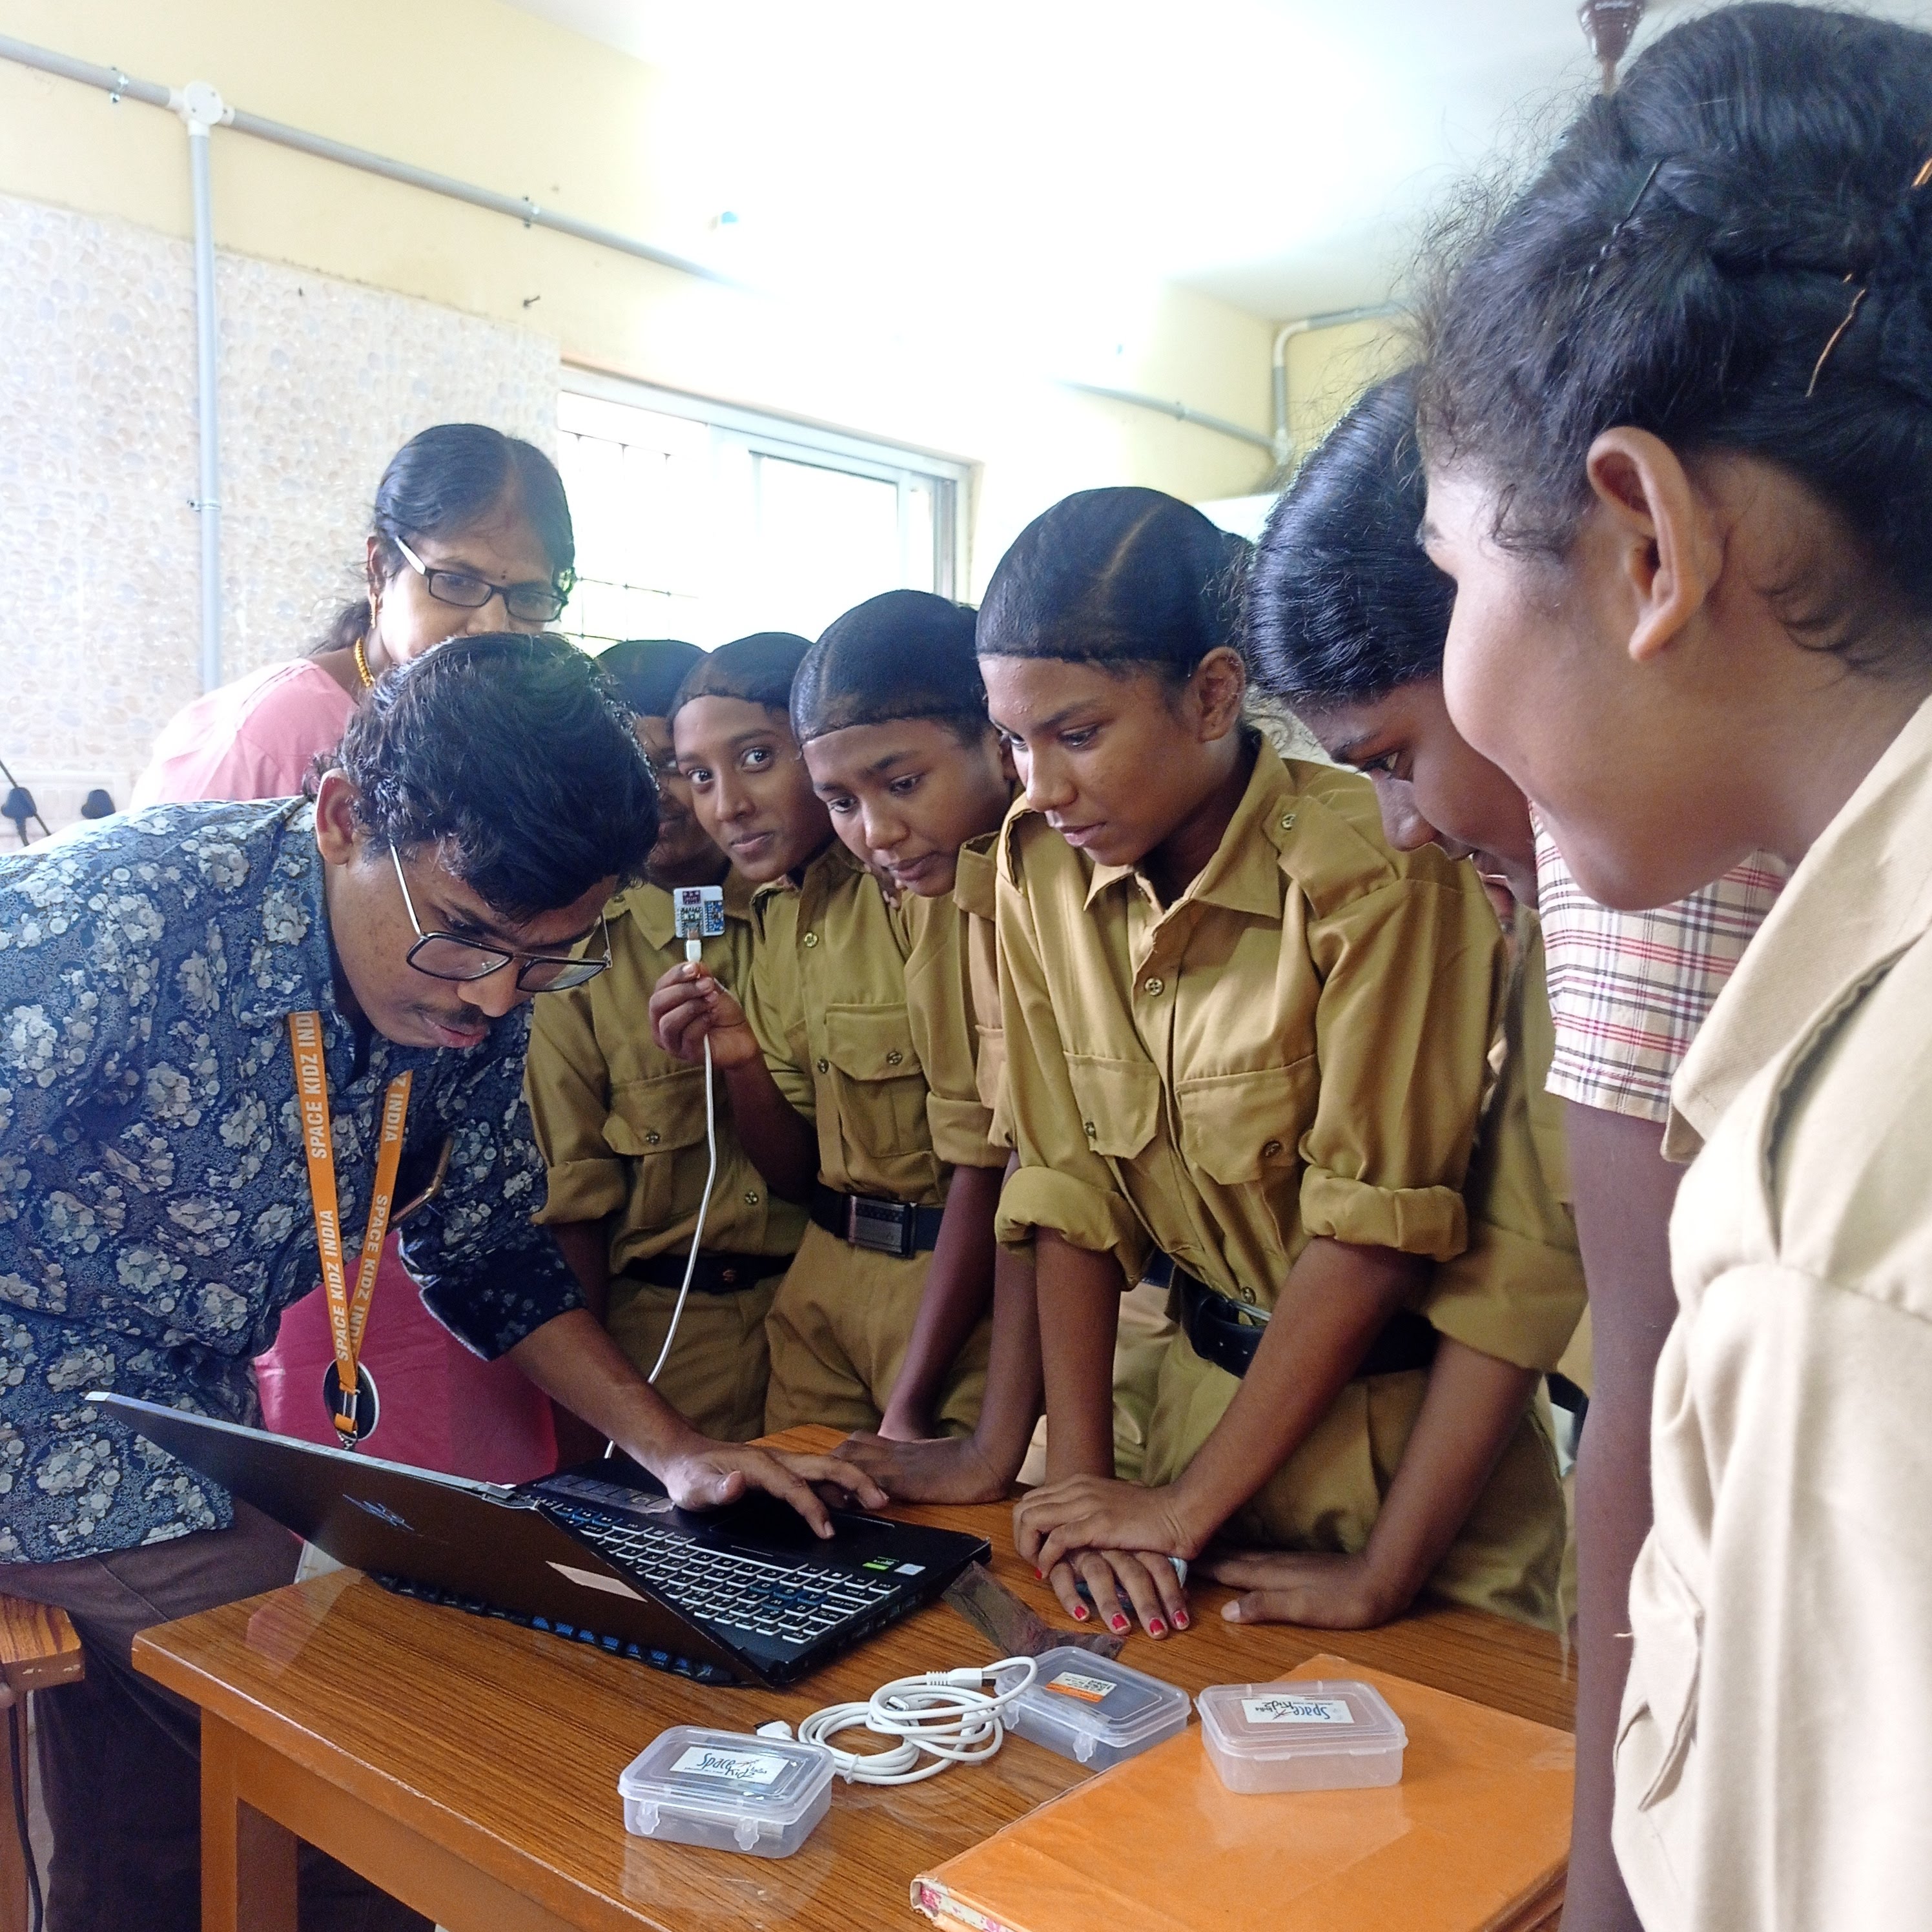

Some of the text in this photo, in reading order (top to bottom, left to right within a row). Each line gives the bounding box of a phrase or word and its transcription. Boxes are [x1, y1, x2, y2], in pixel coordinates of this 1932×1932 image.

[296, 1012, 327, 1159] SPACE KIDZ IND
[384, 1093, 404, 1142] INDIA
[367, 1194, 388, 1253] SPACE
[319, 1209, 349, 1361] SPACE KIDZ INDIA
[357, 1258, 376, 1301] KIDZ
[1293, 1703, 1331, 1720] Space
[696, 1752, 736, 1770] Space
[724, 1765, 755, 1779] Kidz
